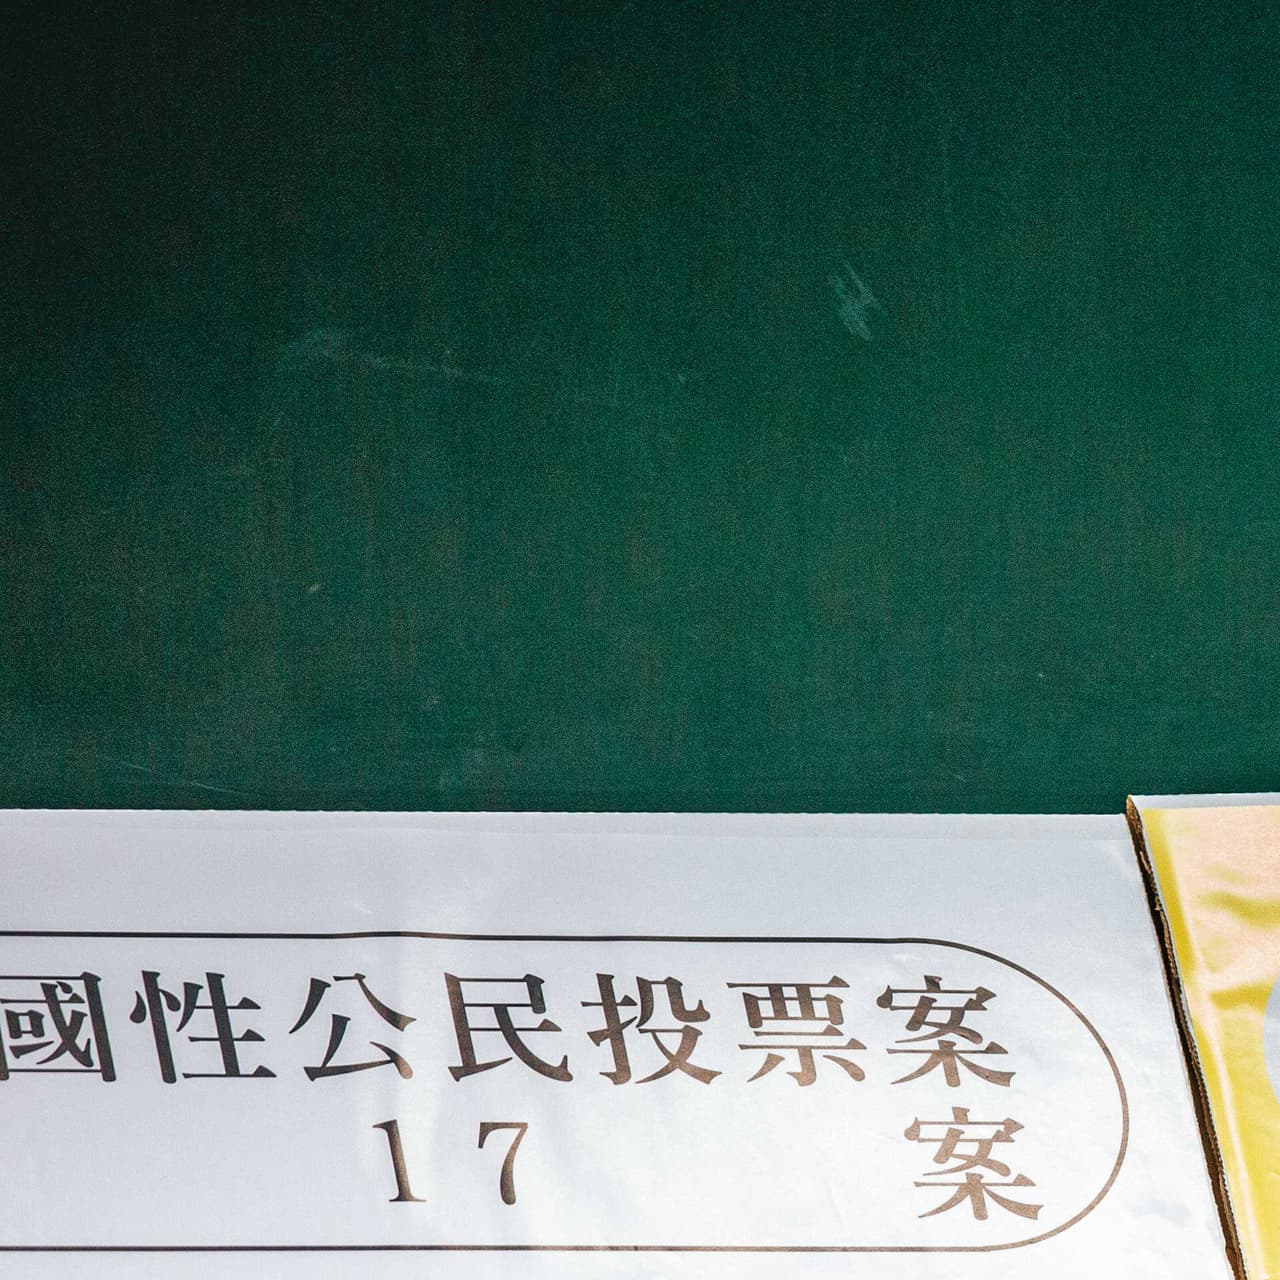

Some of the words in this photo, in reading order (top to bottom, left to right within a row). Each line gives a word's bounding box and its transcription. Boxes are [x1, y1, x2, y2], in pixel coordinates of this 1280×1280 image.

[0, 969, 1018, 1088] 國性公民投票案
[372, 1118, 529, 1206] 17
[903, 1106, 1043, 1221] 案
